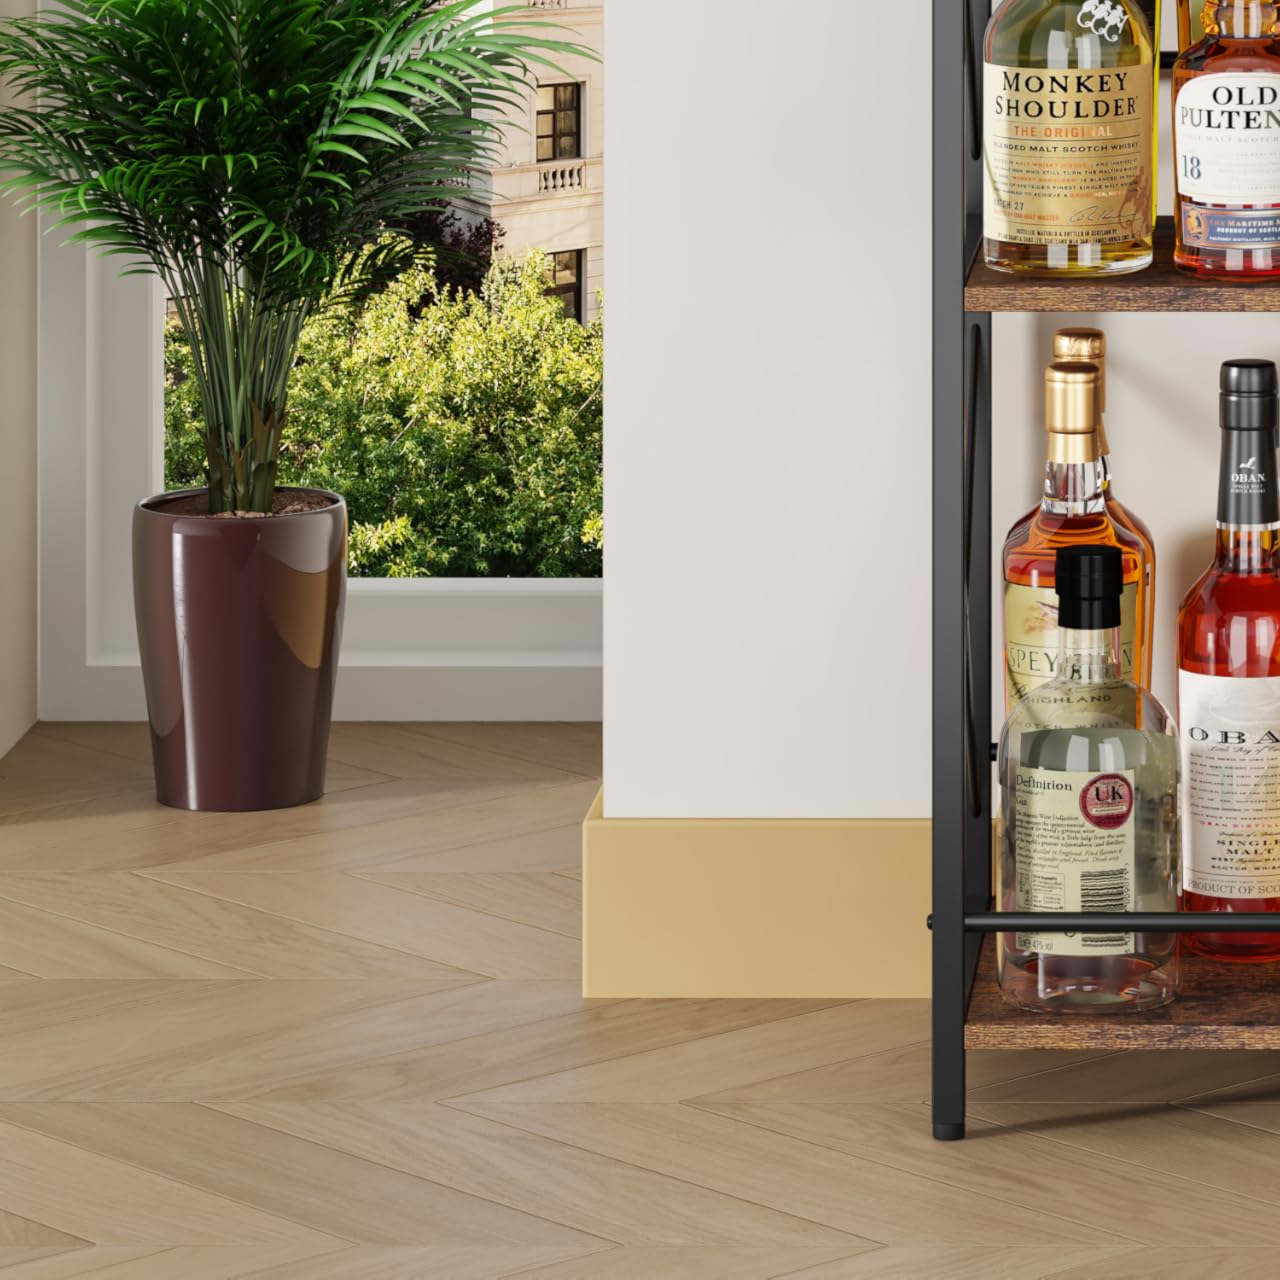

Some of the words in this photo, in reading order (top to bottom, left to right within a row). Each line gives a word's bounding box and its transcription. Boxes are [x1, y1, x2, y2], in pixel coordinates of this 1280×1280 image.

[1002, 71, 1128, 94] MONKEY
[1212, 86, 1278, 106] OLD
[995, 95, 1136, 119] SHOULDER
[1014, 125, 1037, 137] THE
[1044, 126, 1113, 138] ORIGINAL
[1030, 145, 1058, 153] MALT
[1062, 145, 1108, 153] SCOTCH
[1111, 141, 1139, 151] WHISKY
[1183, 154, 1202, 180] 18
[1014, 201, 1025, 212] 27
[1231, 473, 1267, 483] OBAN
[1026, 694, 1113, 704] HIGHLAND
[1016, 775, 1073, 792] Definition
[1094, 785, 1124, 802] UK
[1225, 848, 1274, 856] MALT
[1187, 878, 1237, 895] PRODUCT
[1237, 884, 1256, 895] OF
